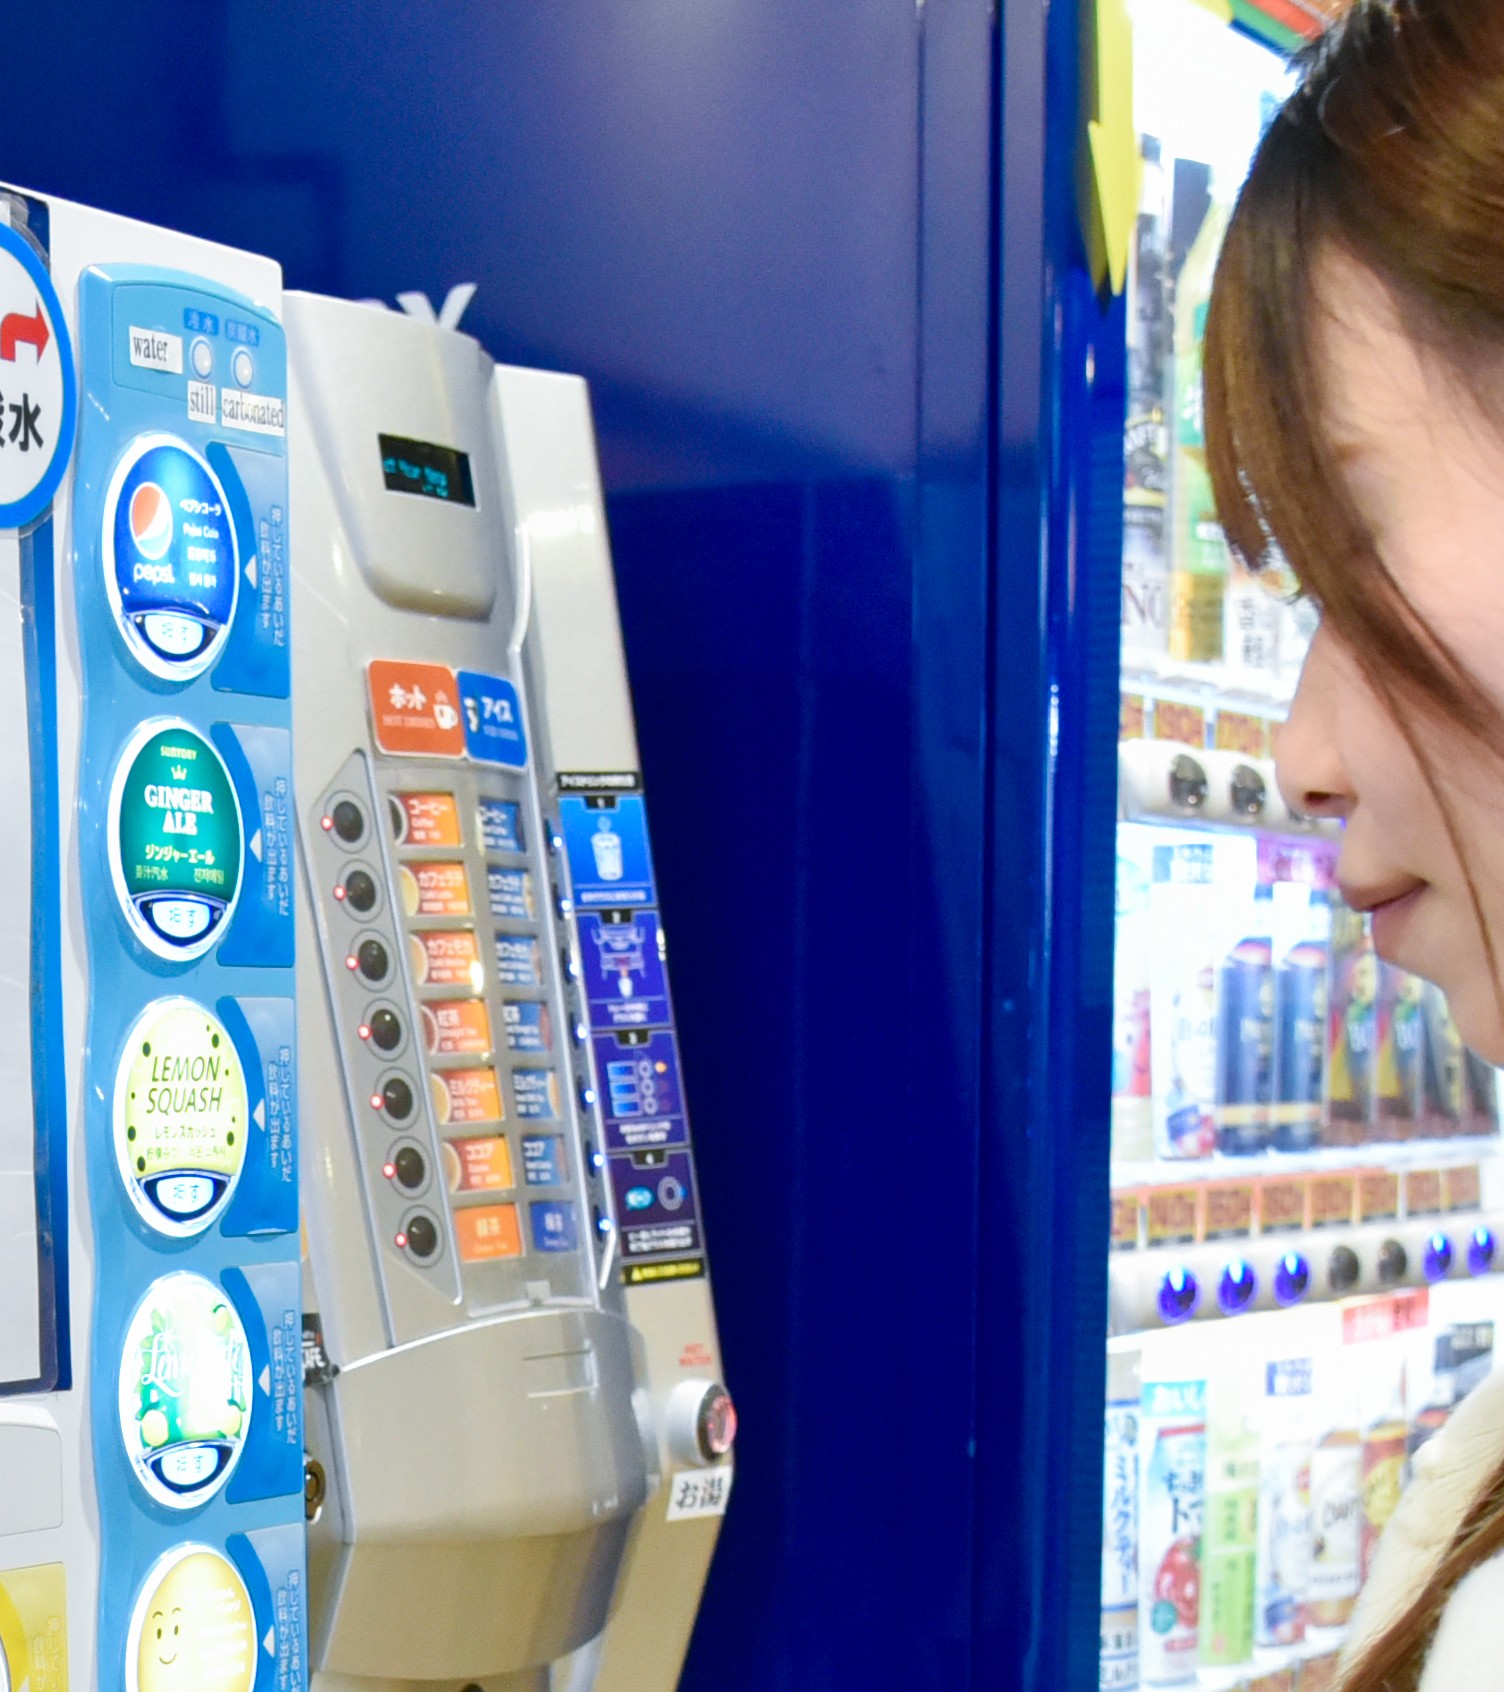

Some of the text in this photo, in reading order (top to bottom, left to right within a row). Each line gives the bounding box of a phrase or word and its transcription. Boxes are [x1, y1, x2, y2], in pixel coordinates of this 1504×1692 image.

[132, 334, 168, 363] water
[189, 388, 285, 429] still carbonated
[144, 785, 213, 814] GINGER
[162, 811, 198, 835] ALE
[151, 1056, 221, 1082] LEMON
[146, 1087, 222, 1114] SQUASH
[677, 1477, 723, 1511] お湯
